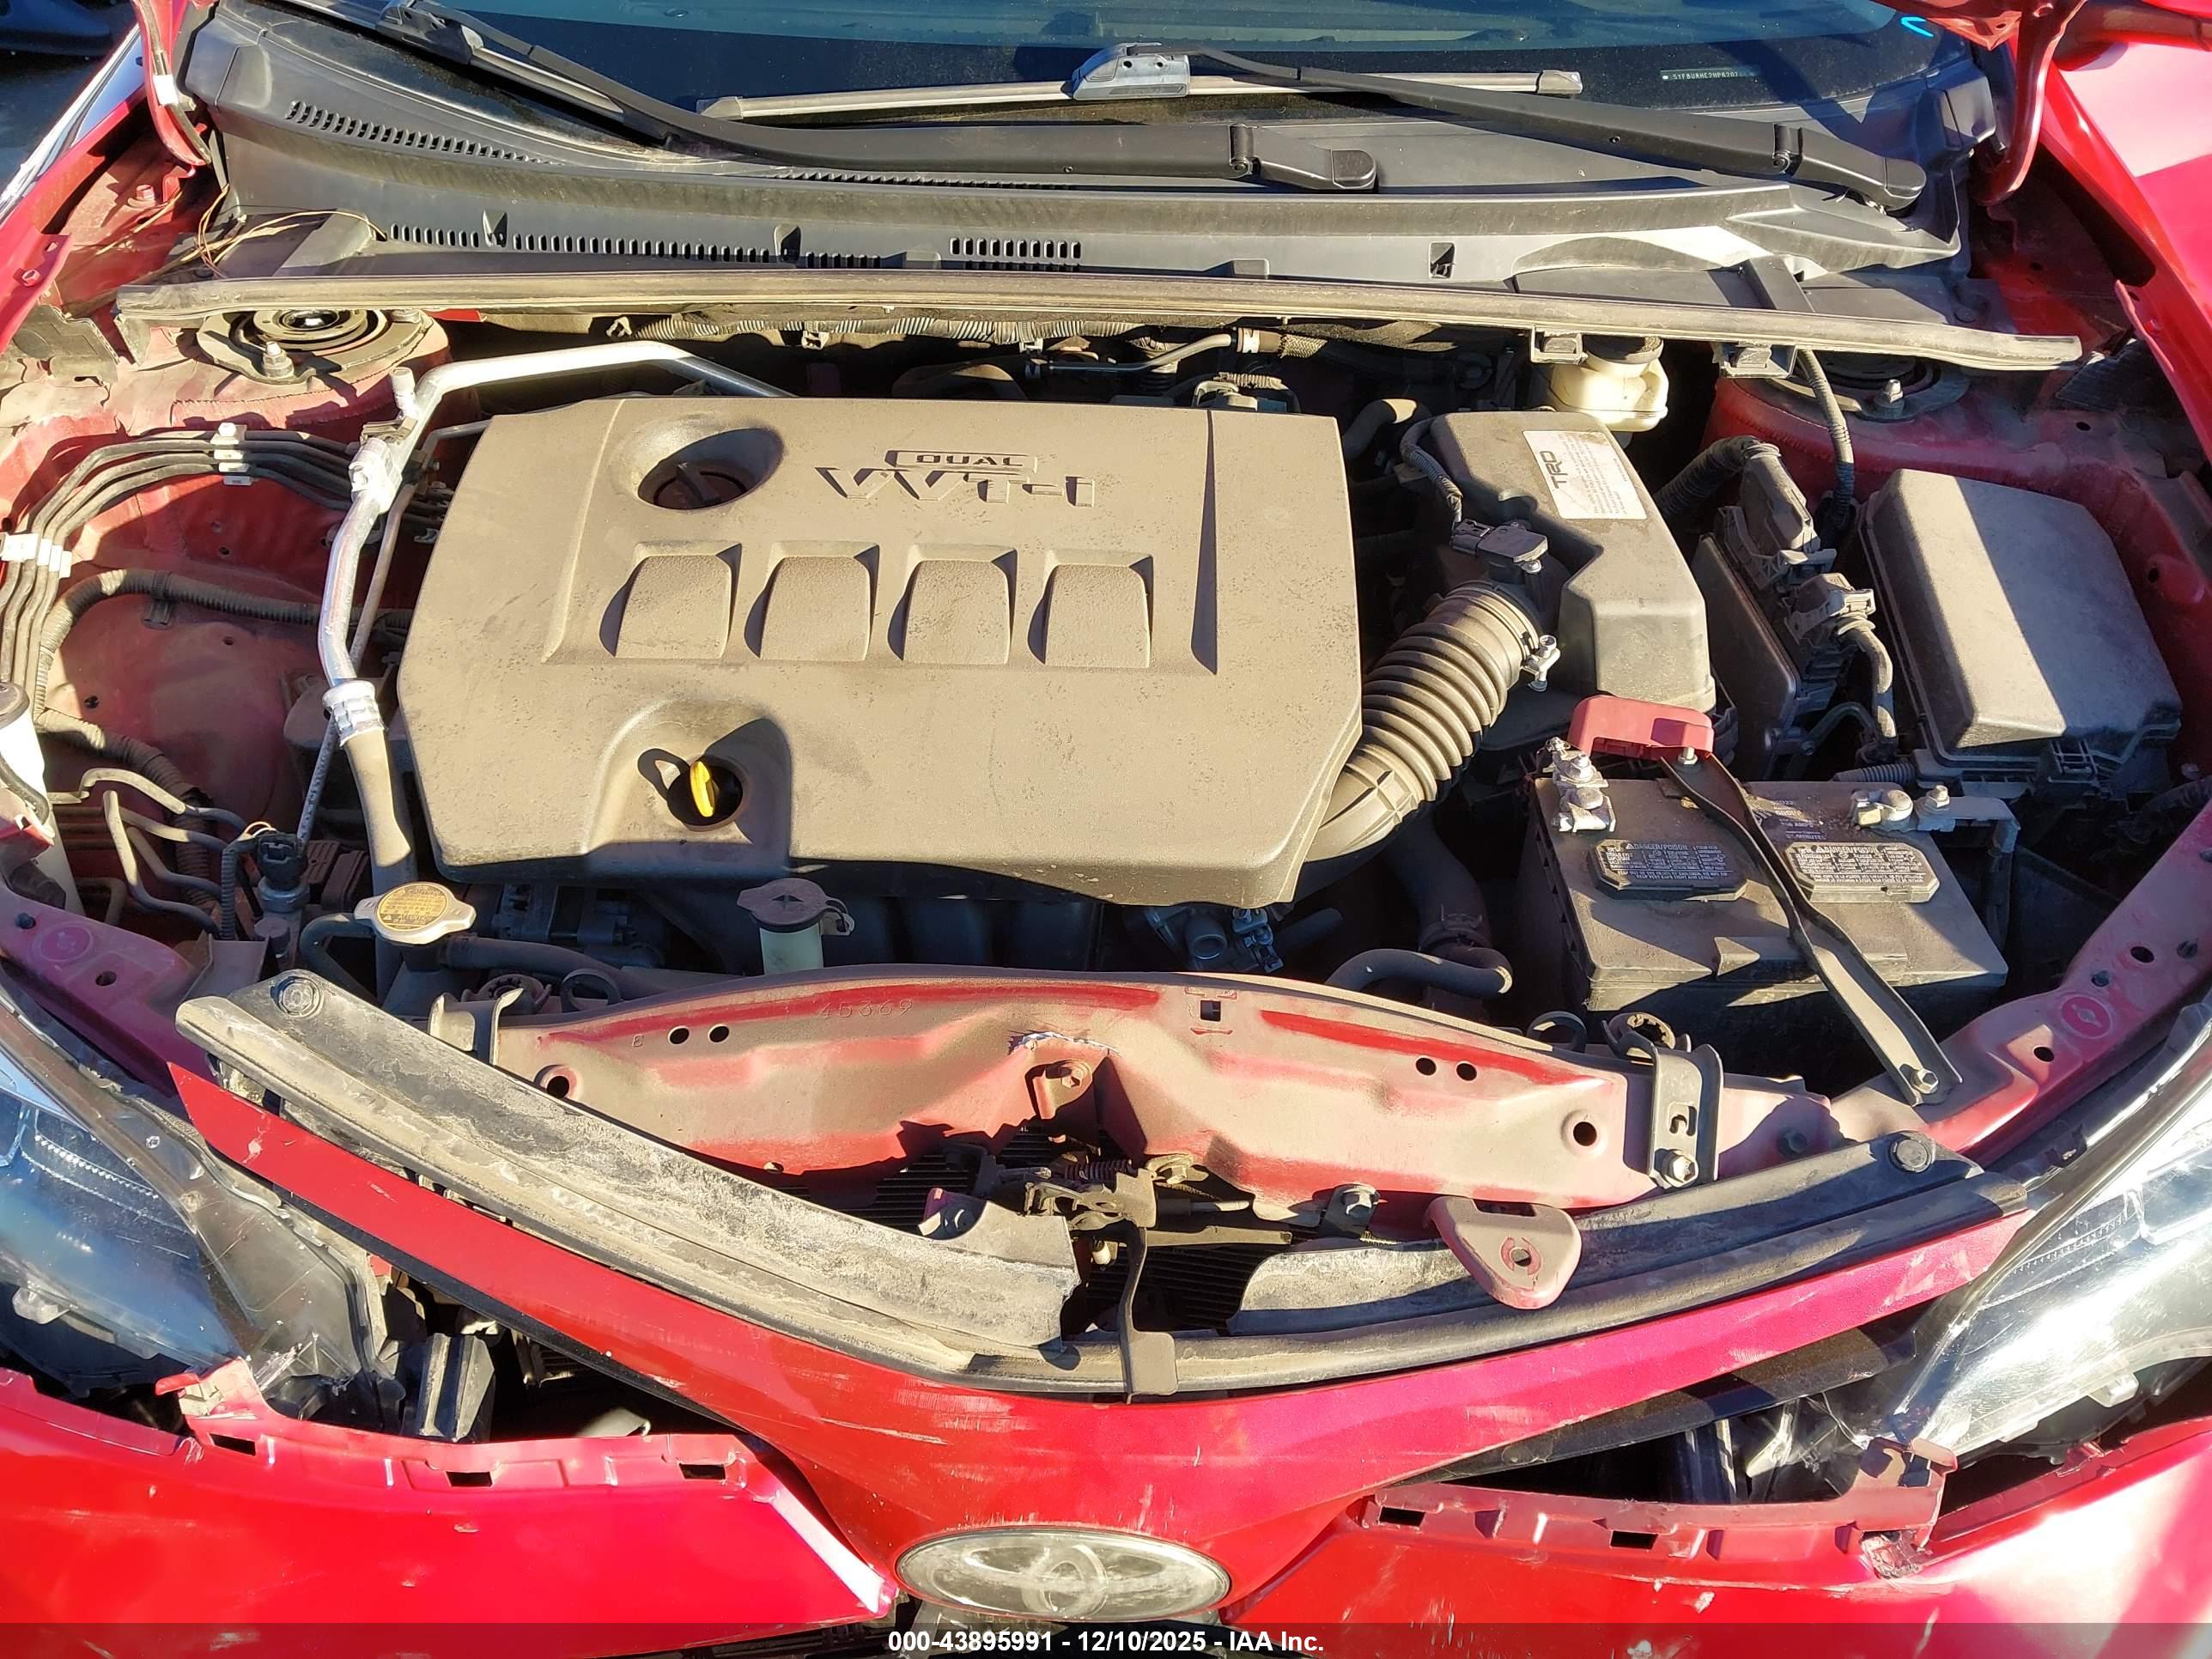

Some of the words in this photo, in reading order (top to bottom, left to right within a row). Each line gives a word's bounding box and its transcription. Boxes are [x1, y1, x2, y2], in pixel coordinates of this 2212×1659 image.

[917, 454, 1023, 466] DUAL
[1540, 451, 1568, 489] TRD
[820, 999, 912, 1018] 45369
